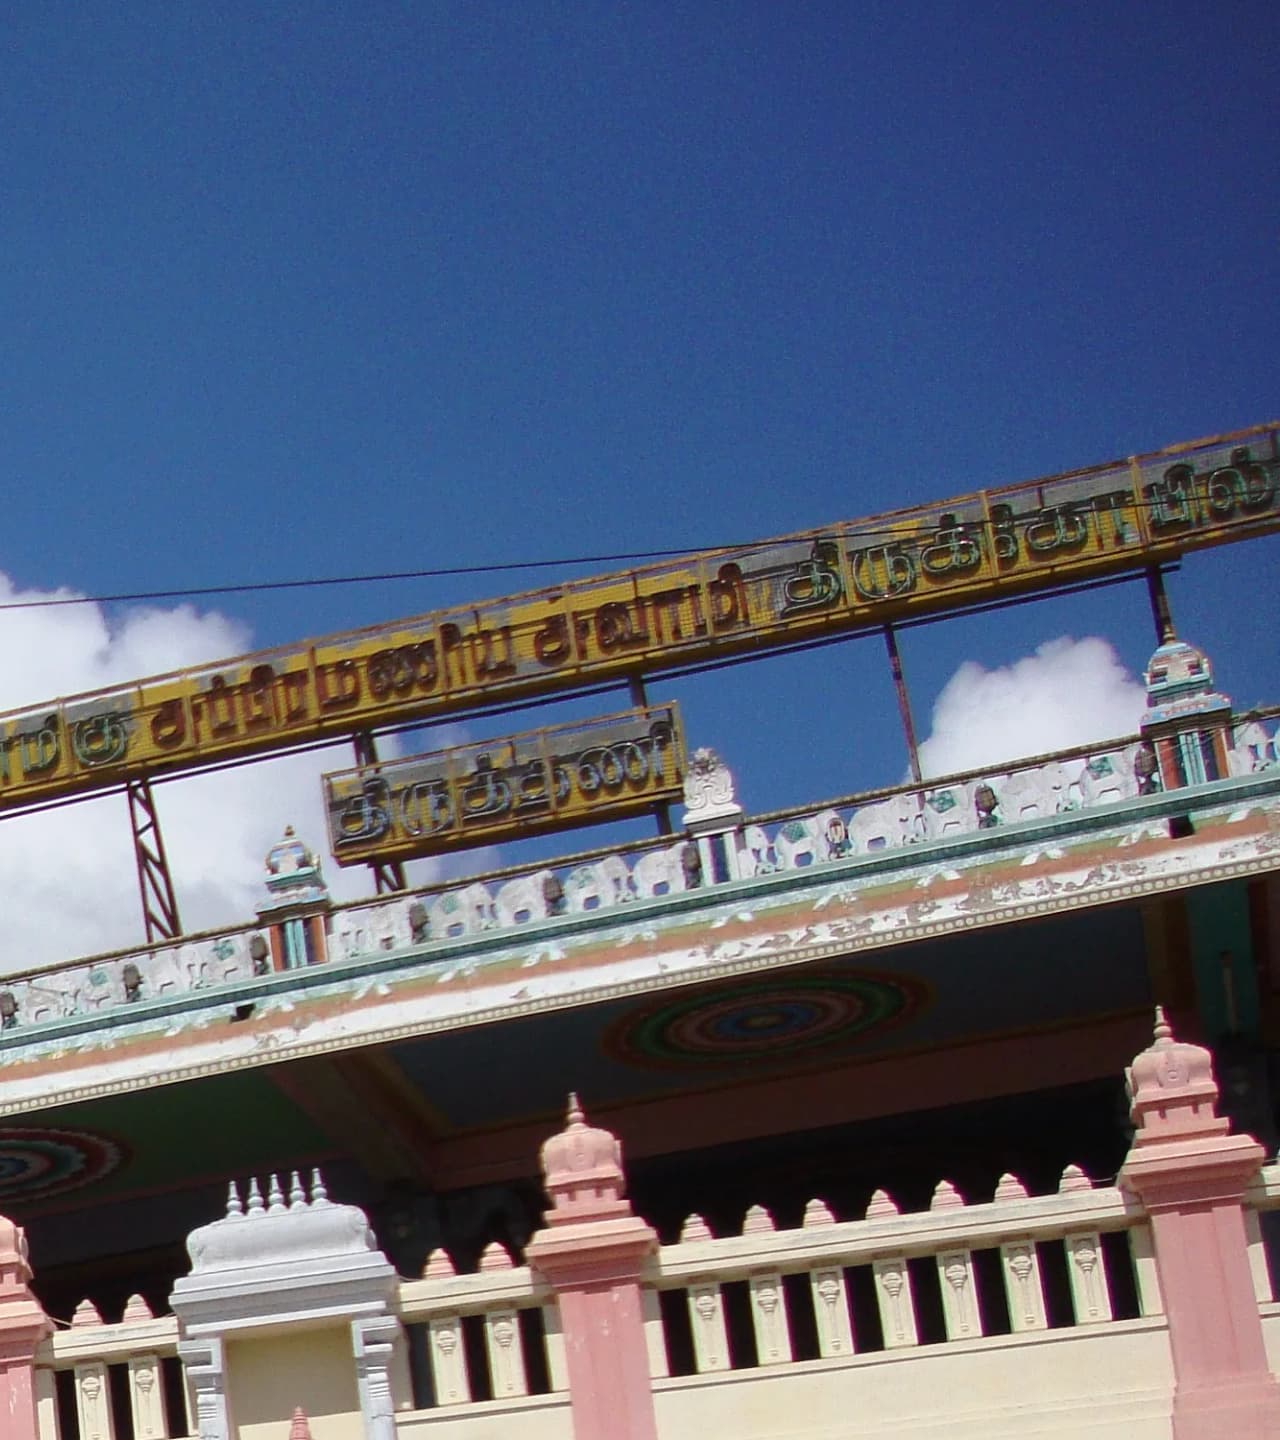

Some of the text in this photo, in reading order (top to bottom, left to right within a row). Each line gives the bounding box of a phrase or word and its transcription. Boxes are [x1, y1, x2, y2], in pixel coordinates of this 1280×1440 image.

[151, 622, 517, 750] சுப்பிரமணிய
[534, 562, 750, 667] சுவாமி
[781, 446, 1275, 618] திருக்கோயில்
[337, 719, 681, 846] திருத்தணி
